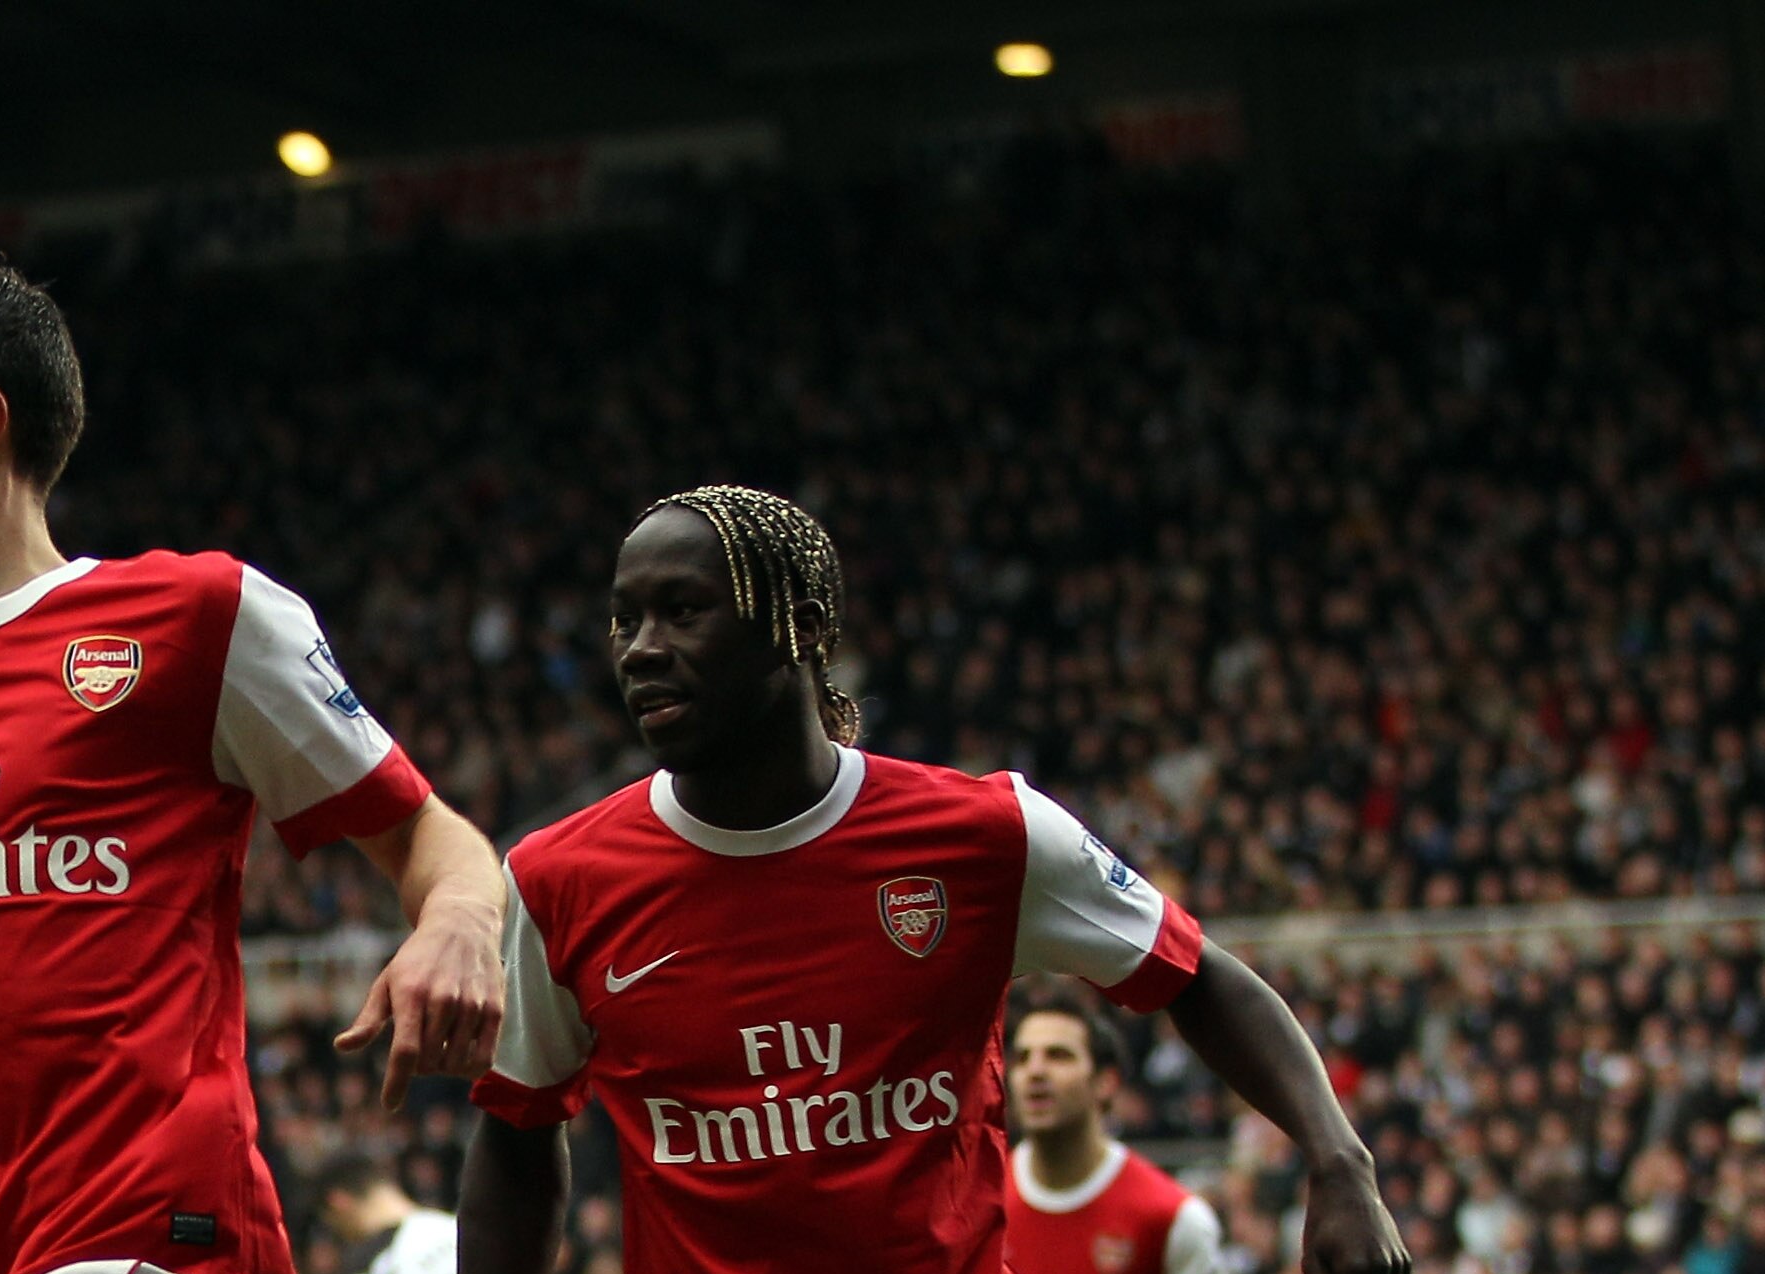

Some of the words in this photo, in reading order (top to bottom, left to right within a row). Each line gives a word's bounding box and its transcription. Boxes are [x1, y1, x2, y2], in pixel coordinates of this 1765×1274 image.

[76, 648, 130, 661] Arsenal
[888, 888, 936, 906] Arsenal
[739, 1021, 843, 1076] Fly
[644, 1071, 959, 1164] Emirates
